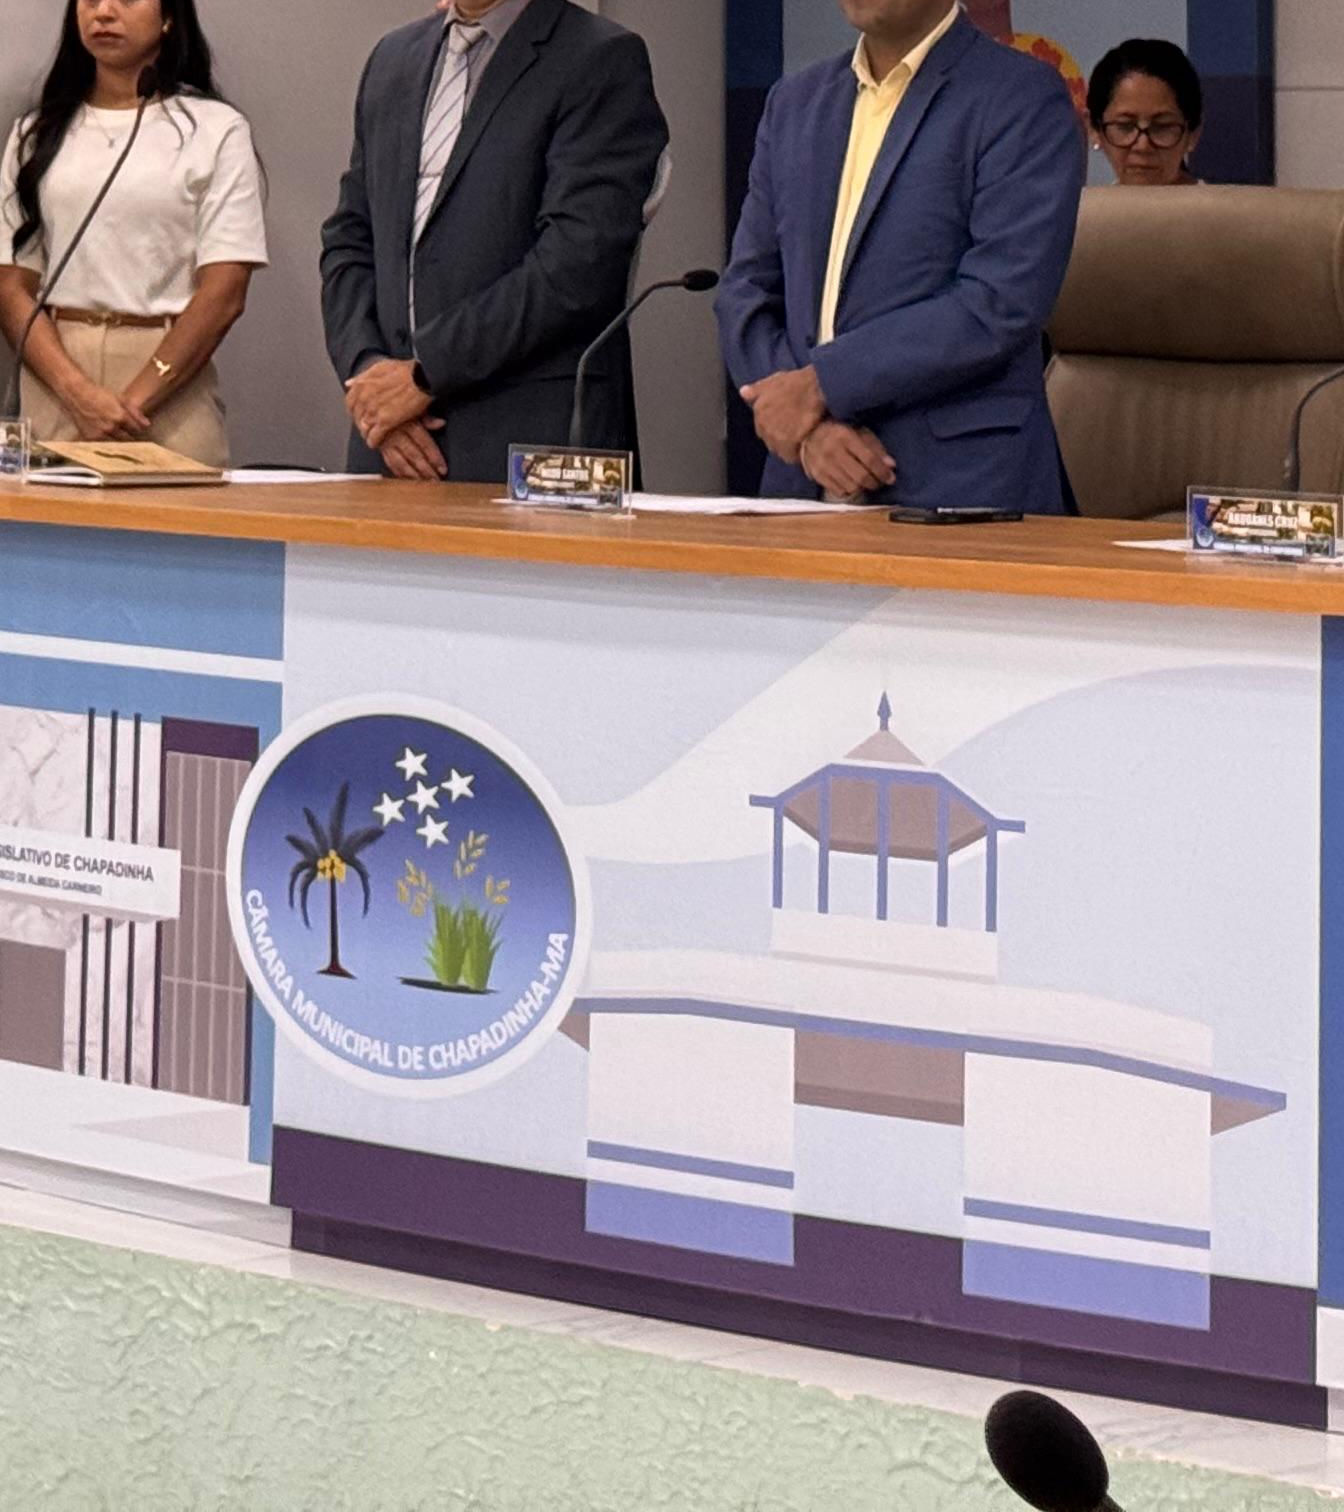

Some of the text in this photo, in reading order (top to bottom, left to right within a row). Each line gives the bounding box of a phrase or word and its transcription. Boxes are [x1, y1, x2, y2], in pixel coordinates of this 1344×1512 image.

[54, 852, 71, 870] DE
[74, 855, 154, 882] CHAPADINHA
[245, 888, 570, 1071] CÂMARA MUNICIPAL DE CHAPADINHA-MA
